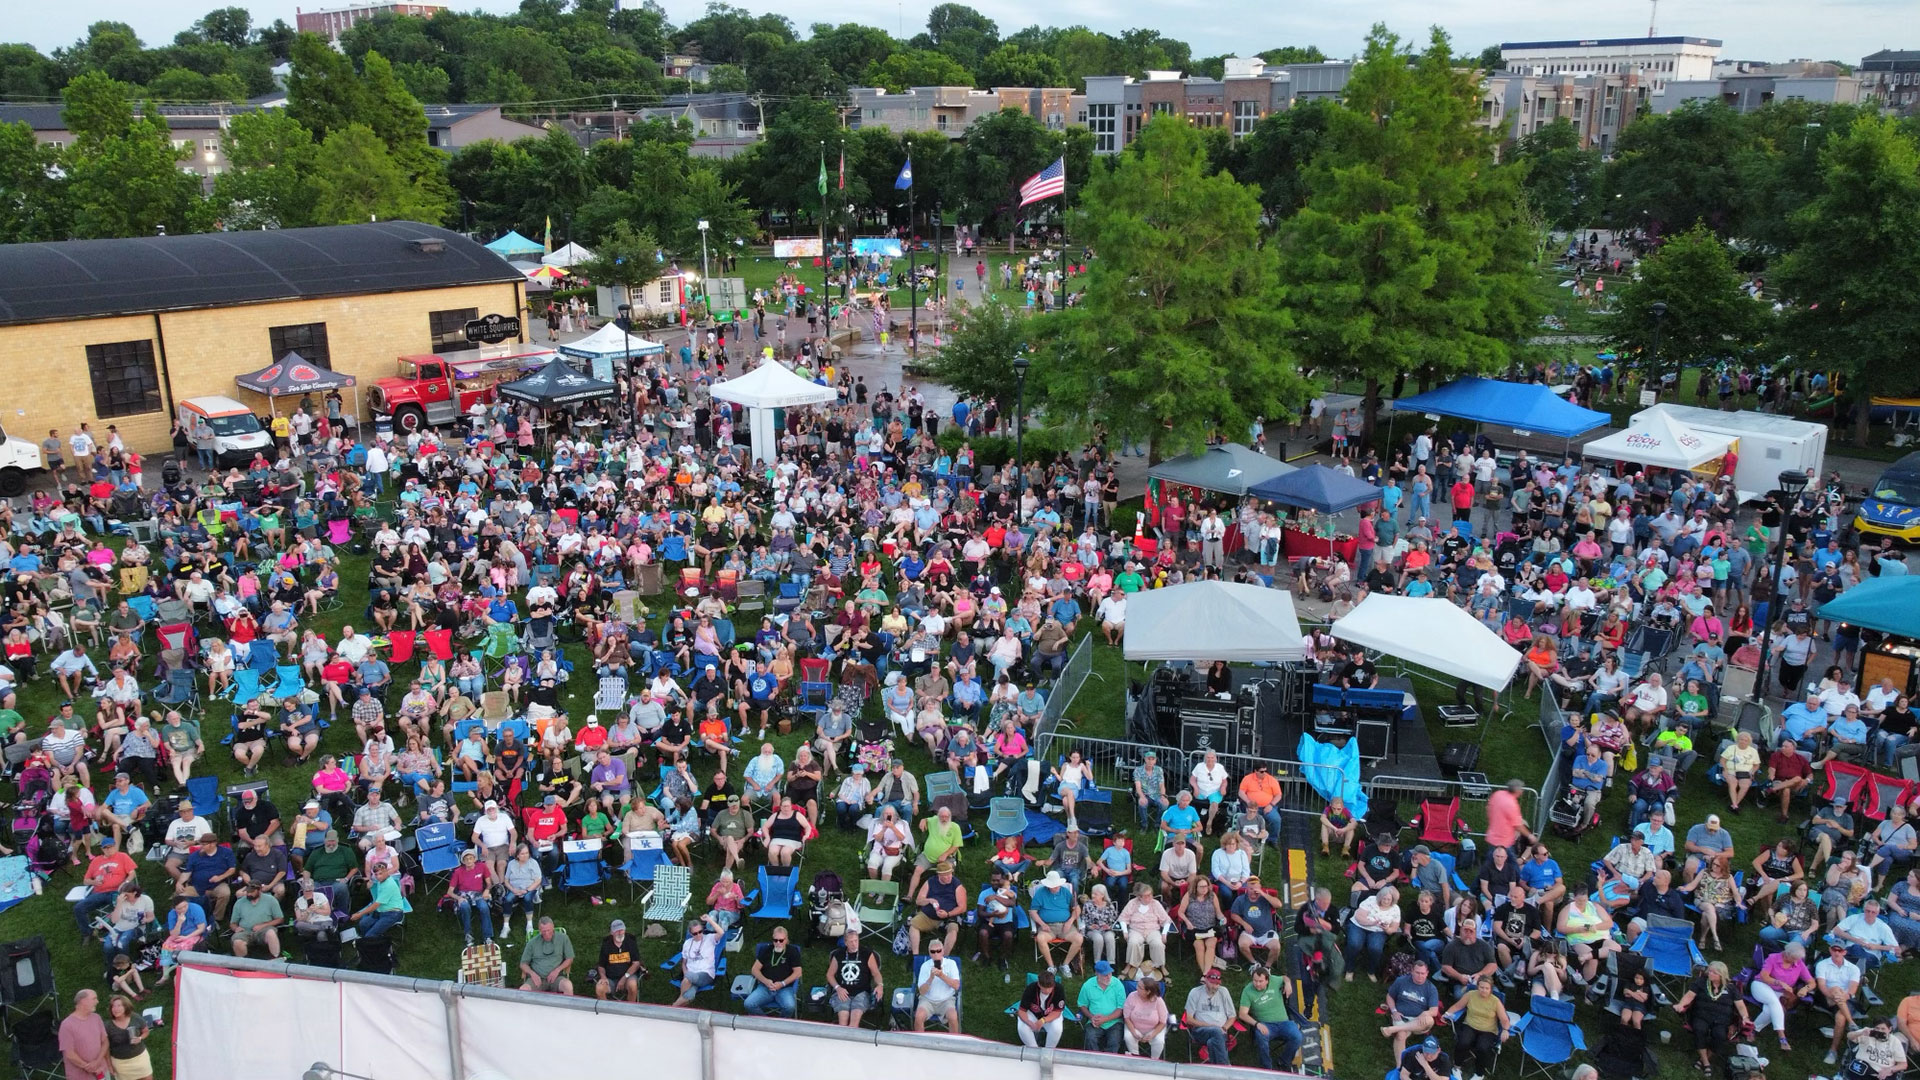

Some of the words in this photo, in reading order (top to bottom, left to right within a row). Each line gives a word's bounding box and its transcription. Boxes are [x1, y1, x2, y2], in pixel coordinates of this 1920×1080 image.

[468, 325, 488, 335] WHITE
[489, 322, 519, 333] SQUIRREL
[300, 383, 312, 391] The
[312, 381, 338, 389] Country
[1626, 442, 1656, 450] LIGHT
[575, 841, 587, 850] UK
[640, 839, 651, 849] UK
